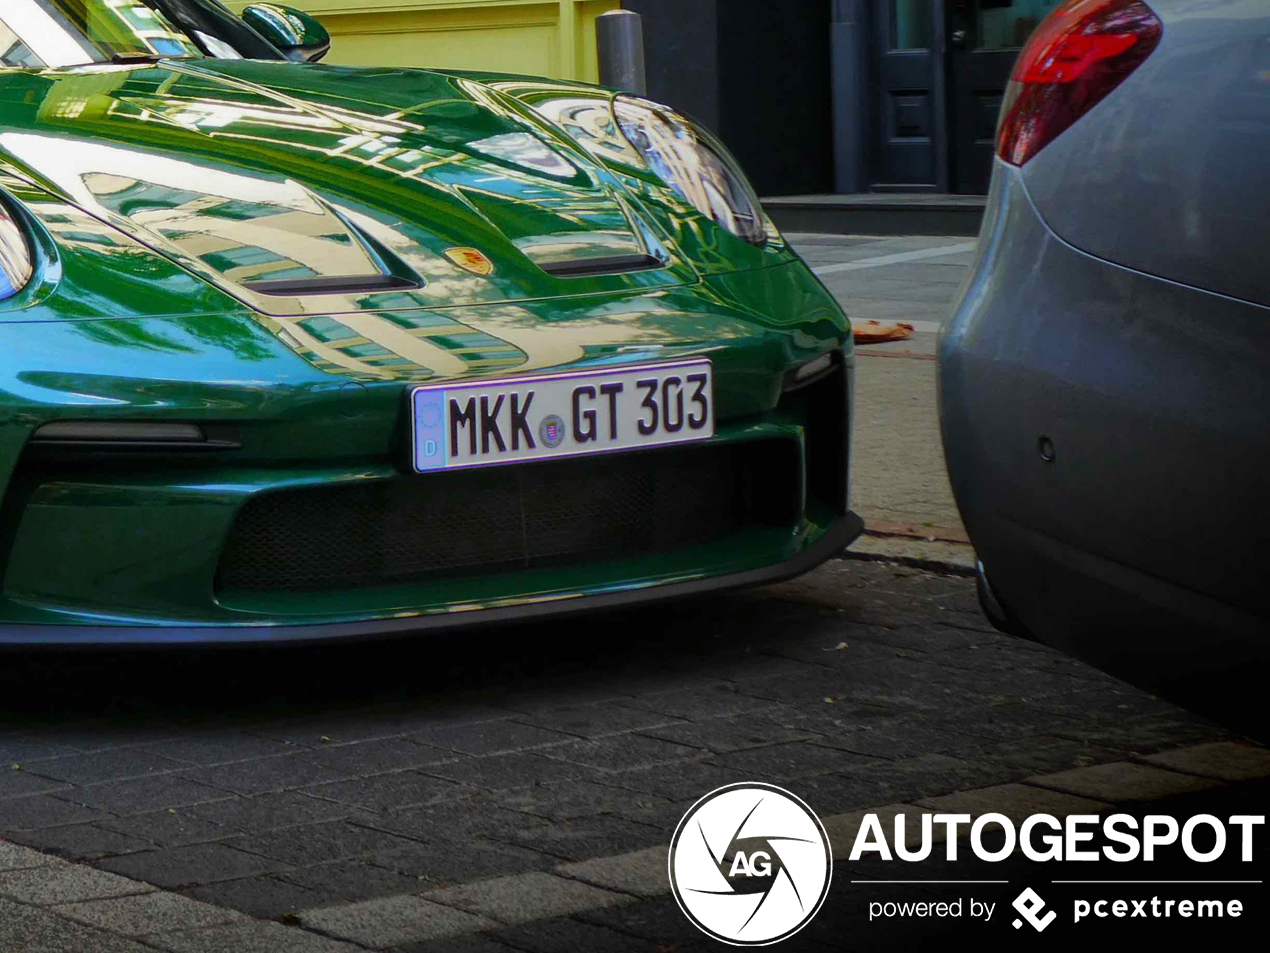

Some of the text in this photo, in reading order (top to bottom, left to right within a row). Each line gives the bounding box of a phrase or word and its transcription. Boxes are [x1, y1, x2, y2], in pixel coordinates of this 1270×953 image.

[425, 373, 708, 457] D MKK GT 303
